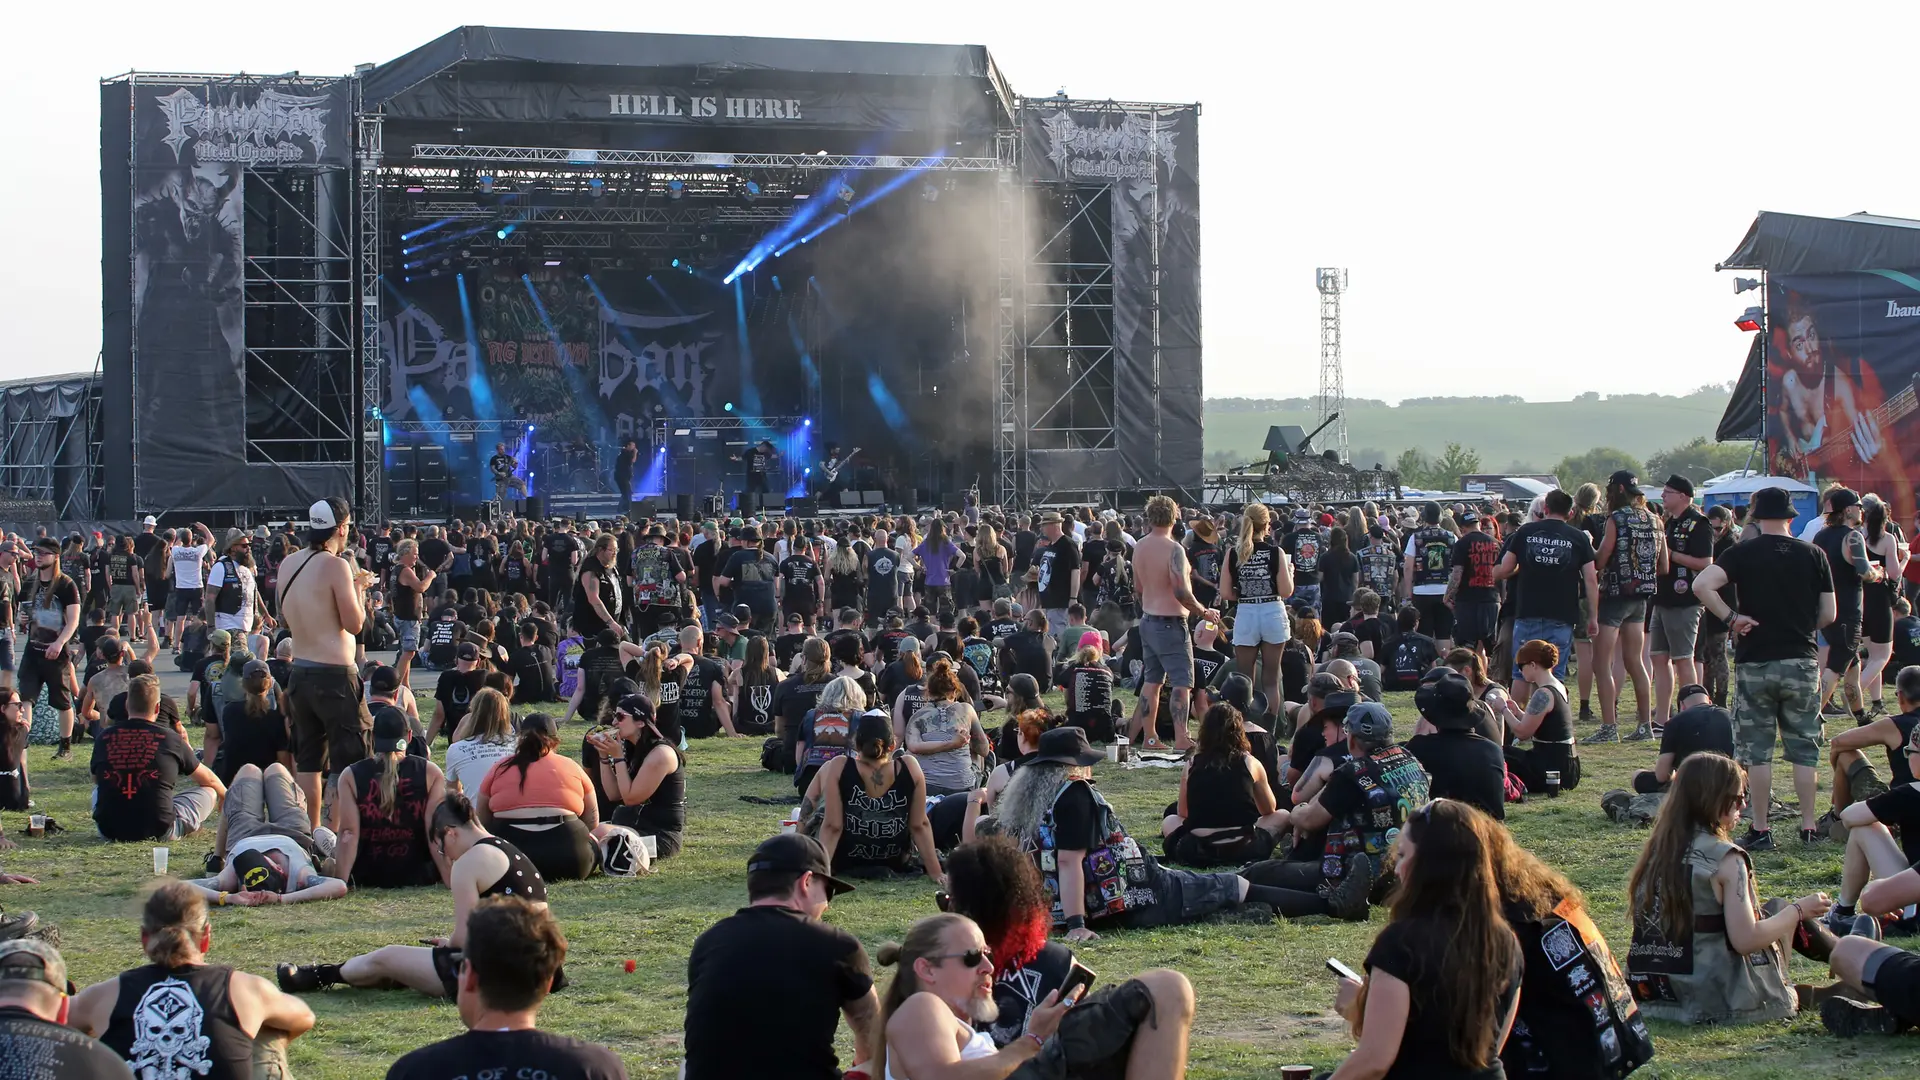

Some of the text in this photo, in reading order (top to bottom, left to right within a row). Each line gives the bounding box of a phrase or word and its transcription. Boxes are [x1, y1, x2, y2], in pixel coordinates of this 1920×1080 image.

[609, 94, 801, 119] HELL IS HERE
[487, 340, 590, 368] PIG DESTROYER
[1475, 541, 1498, 553] CAME
[1526, 536, 1573, 549] TRIUMPH
[1541, 547, 1556, 555] OF
[1469, 553, 1480, 565] TO
[1534, 555, 1560, 565] EVIL
[848, 785, 908, 812] KILL
[848, 843, 900, 860] ALL
[1630, 939, 1684, 958] Bastards
[516, 1067, 559, 1080] CO
